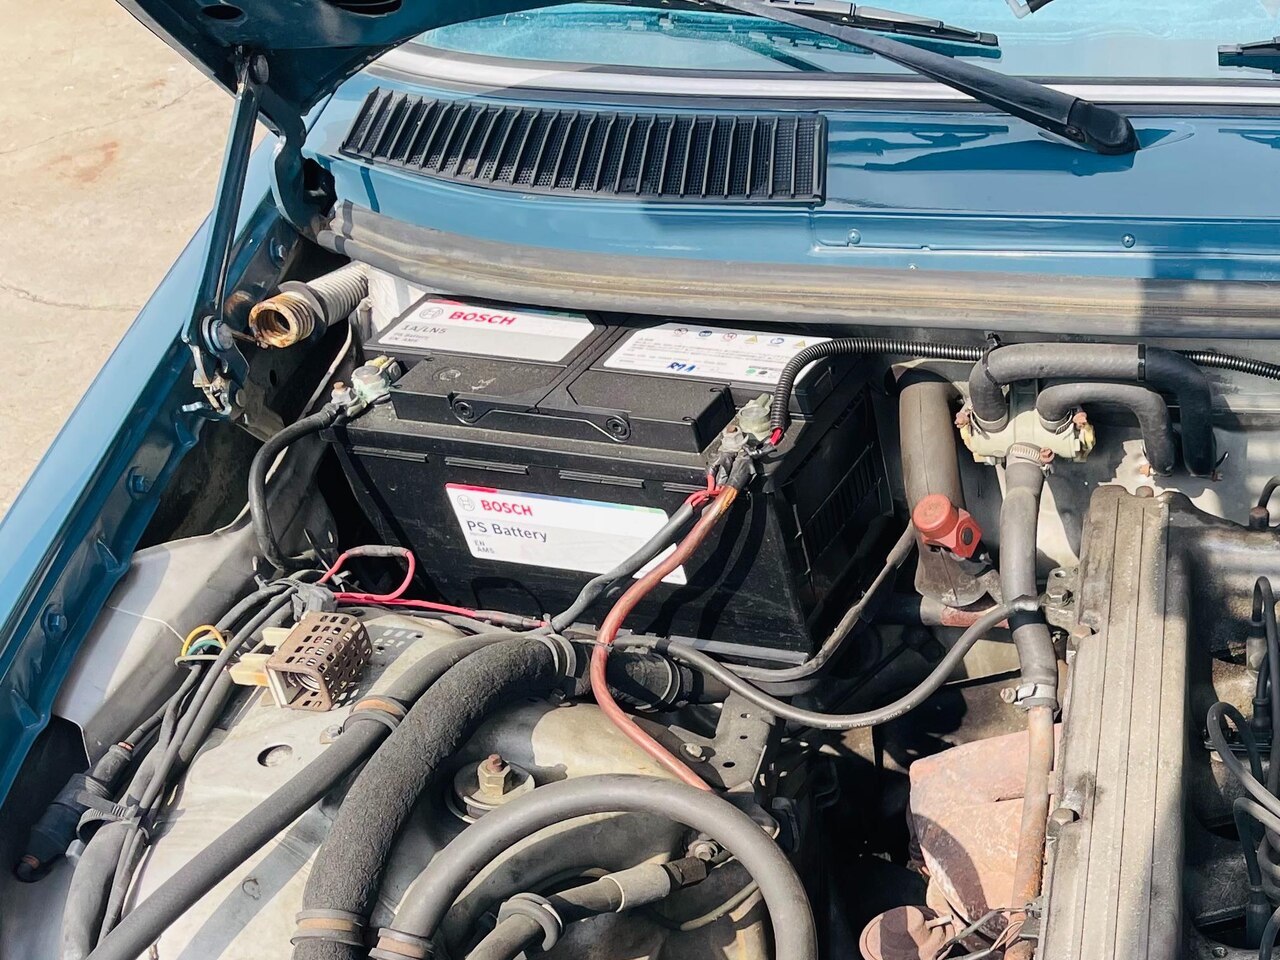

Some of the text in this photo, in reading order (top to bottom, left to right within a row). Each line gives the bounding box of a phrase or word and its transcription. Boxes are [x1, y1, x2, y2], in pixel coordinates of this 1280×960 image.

[449, 311, 517, 326] BOSCH
[481, 499, 533, 516] BOSCH
[467, 520, 547, 542] PS Battery
